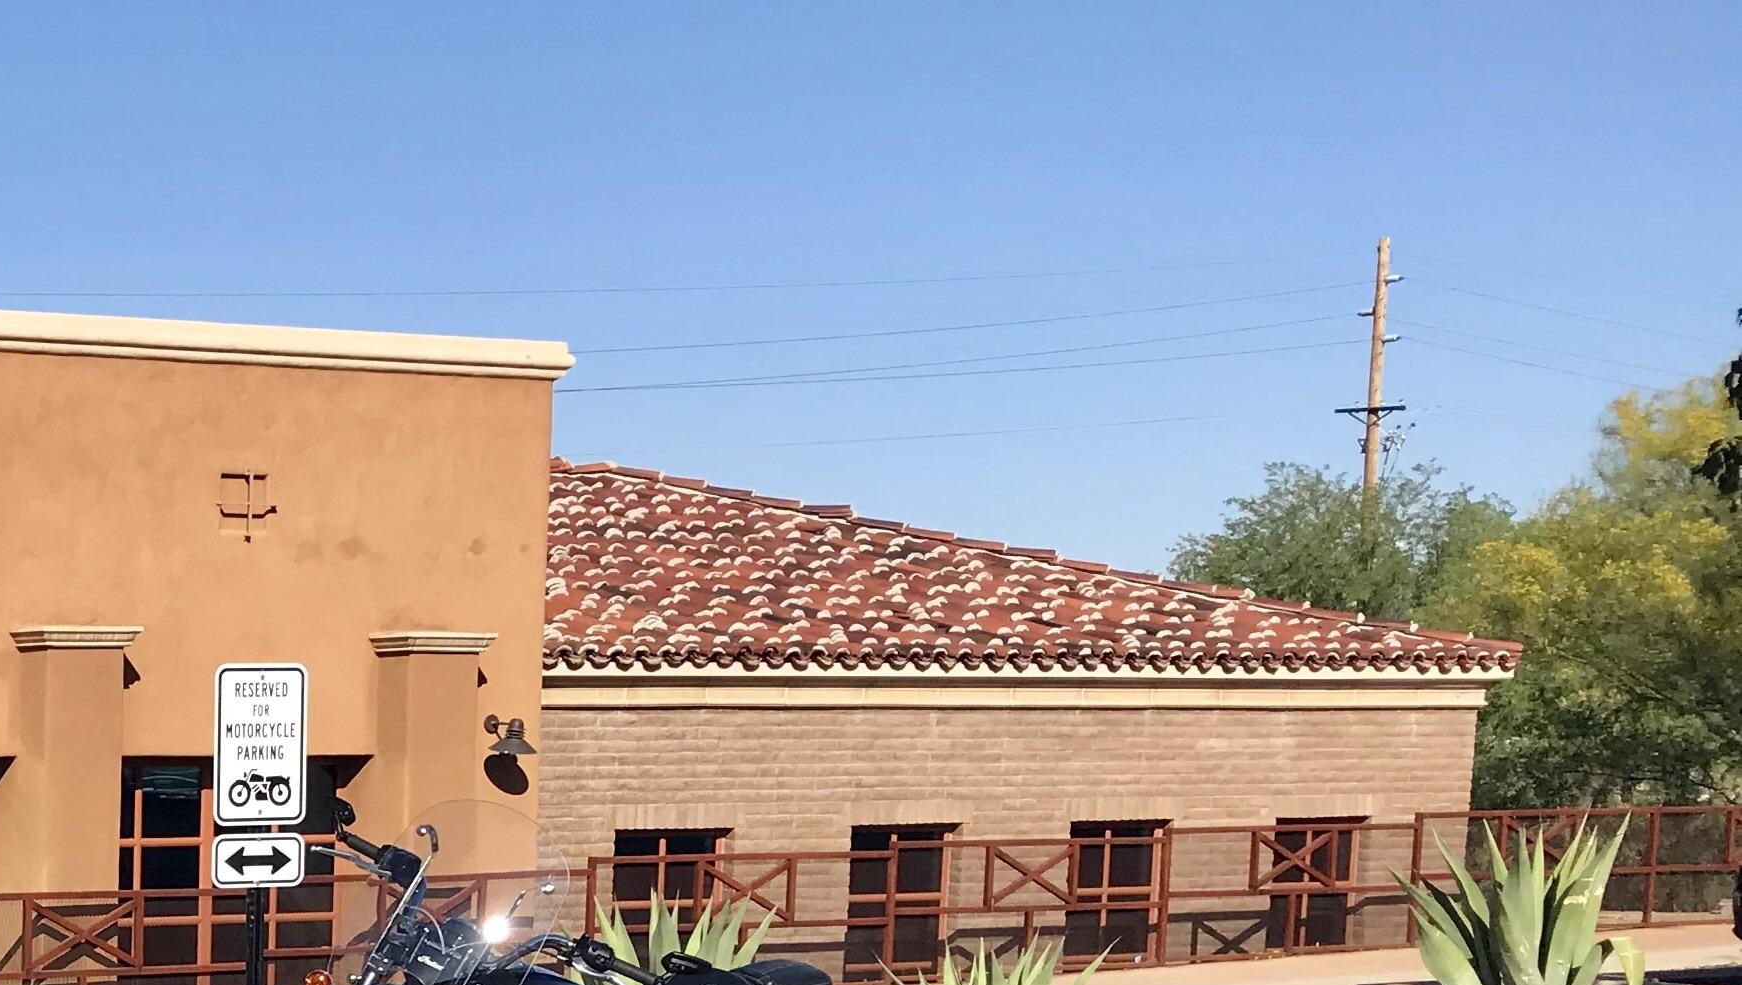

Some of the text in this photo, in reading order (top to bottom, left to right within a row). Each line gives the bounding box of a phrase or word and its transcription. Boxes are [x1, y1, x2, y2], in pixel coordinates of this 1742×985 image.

[234, 682, 288, 698] RESERVED
[252, 704, 270, 717] FOR
[225, 723, 296, 738] MOTORCYCLE
[237, 745, 284, 761] PARKING
